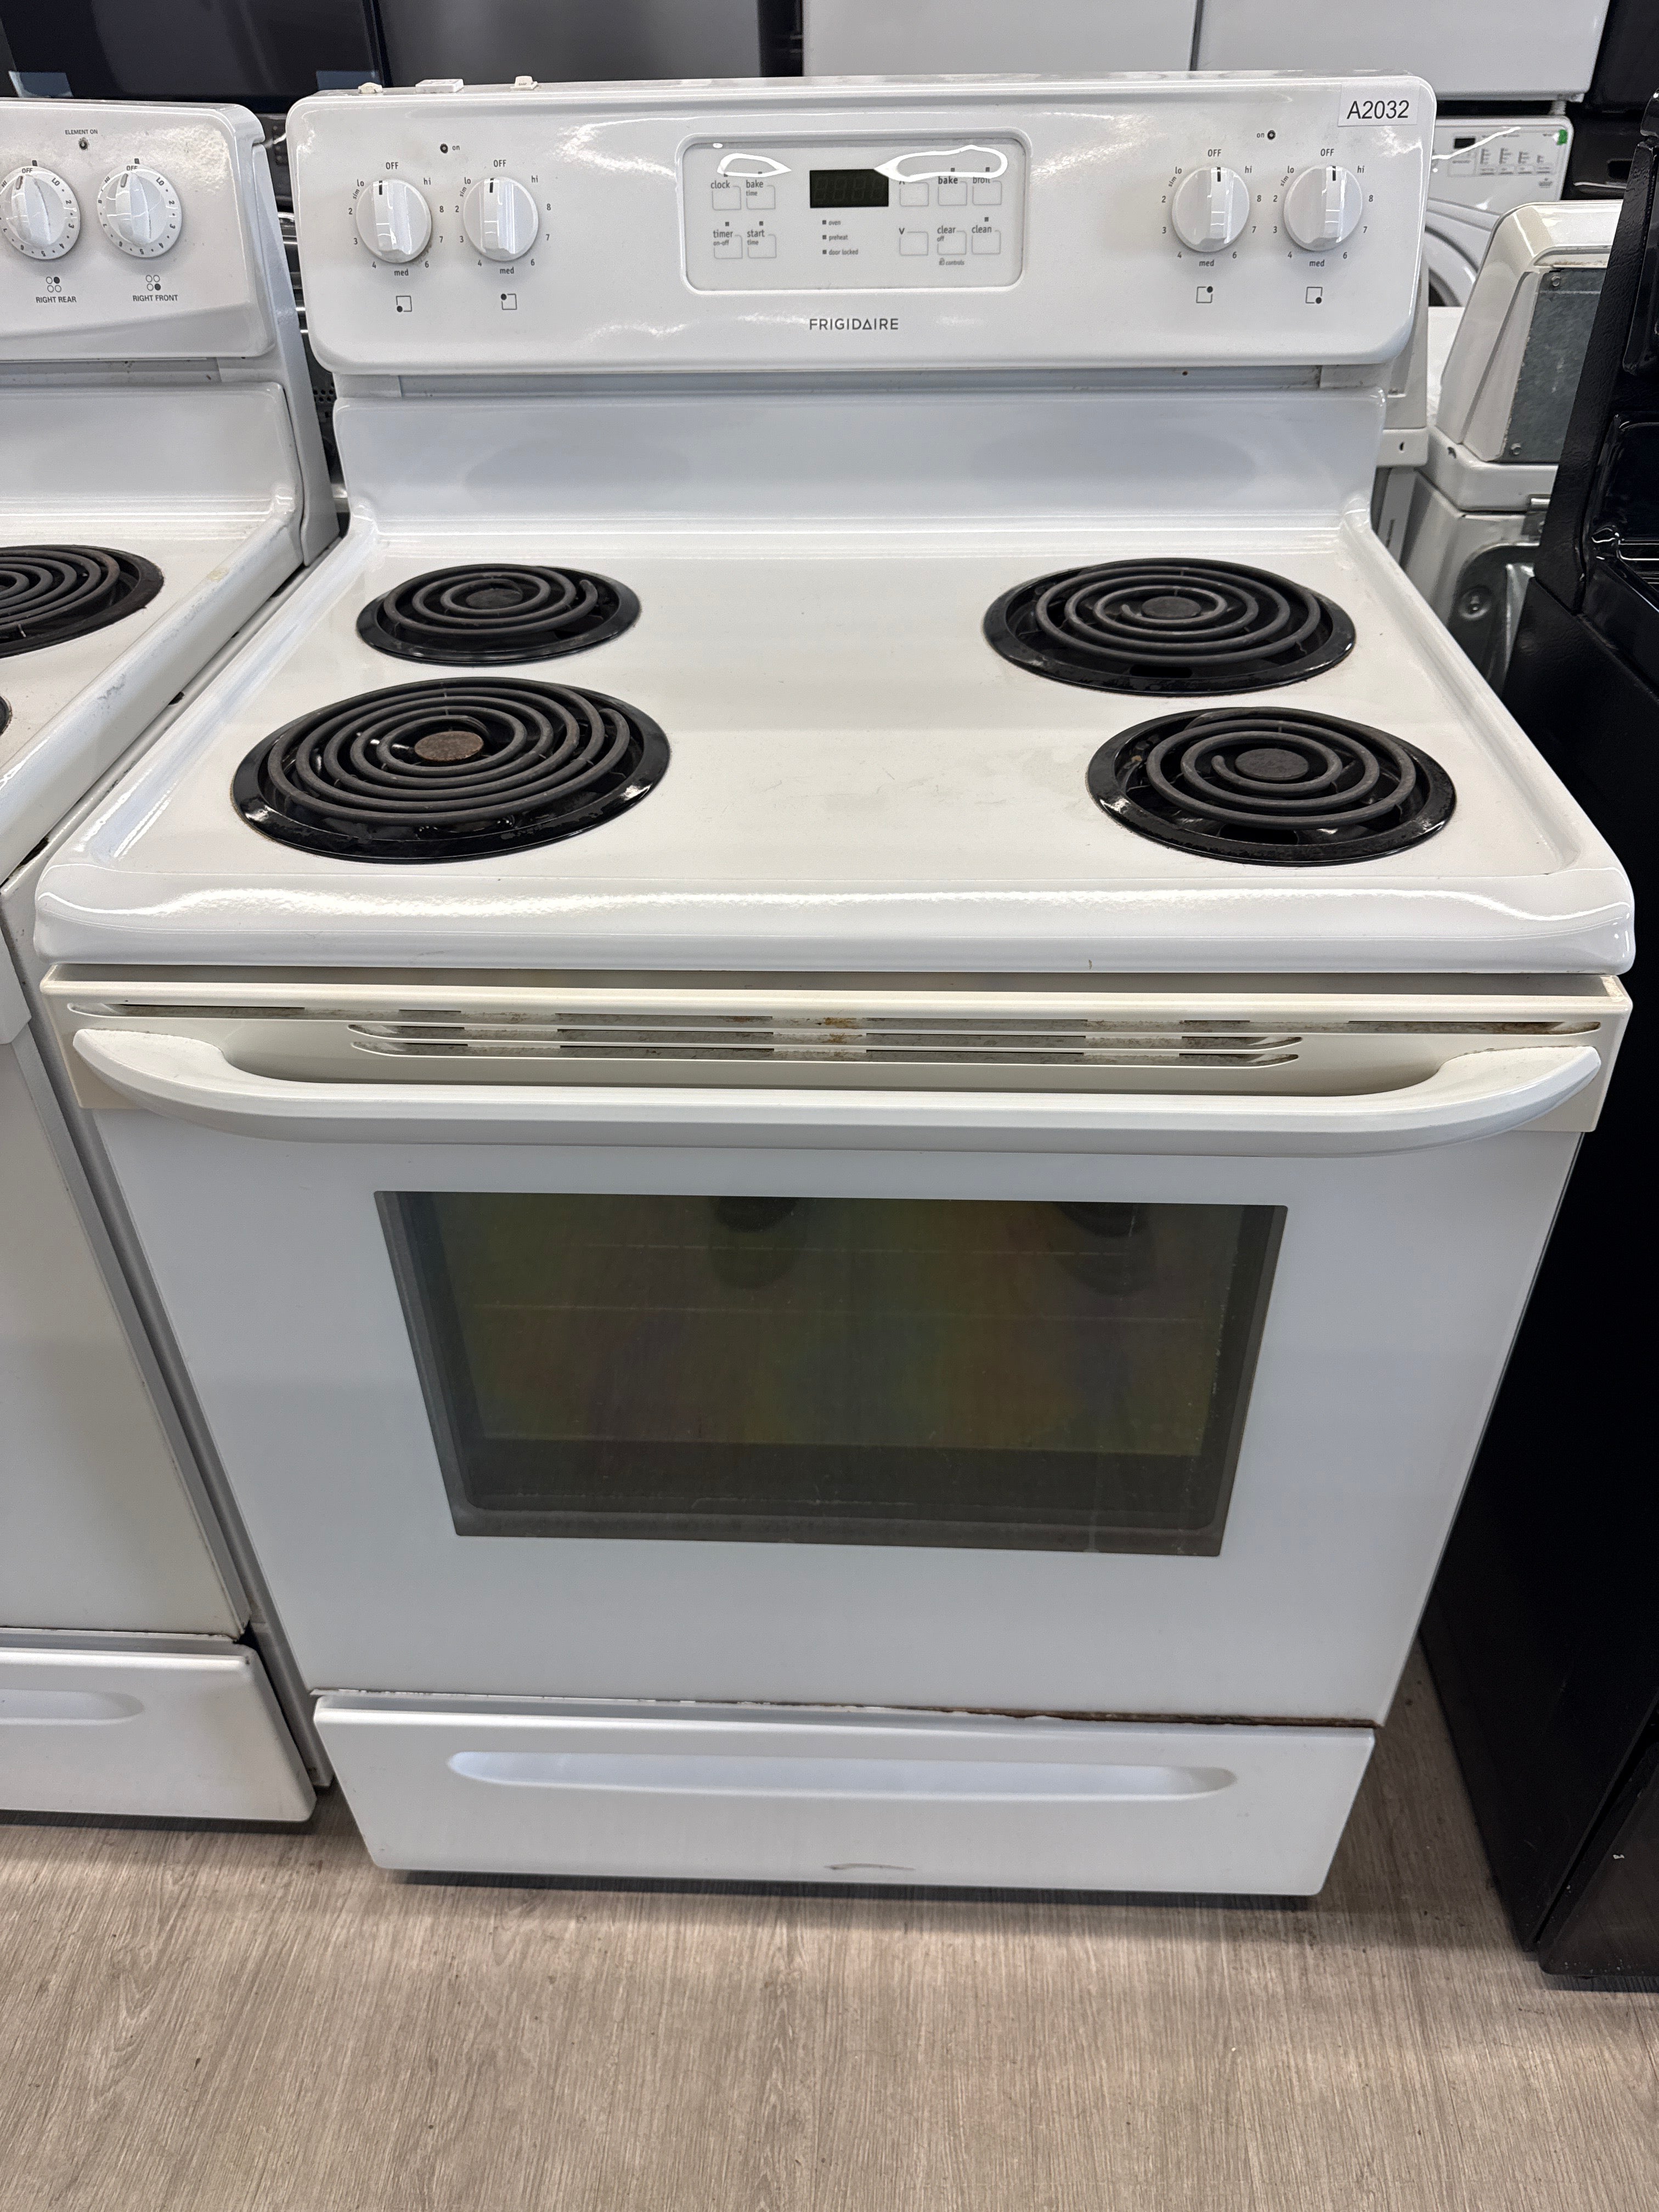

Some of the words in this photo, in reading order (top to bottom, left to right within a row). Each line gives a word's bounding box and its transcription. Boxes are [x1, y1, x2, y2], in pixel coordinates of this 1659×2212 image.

[1347, 100, 1409, 119] A2032
[1357, 165, 1365, 173] hi
[710, 180, 730, 189] clock
[746, 179, 764, 188] bake
[938, 176, 958, 184] bake
[1168, 176, 1177, 187] sim
[1280, 176, 1289, 187] sim
[713, 230, 733, 238] timer
[937, 225, 956, 234] clear
[972, 225, 992, 234] clean
[809, 318, 899, 330] FRIGIDAIRE
